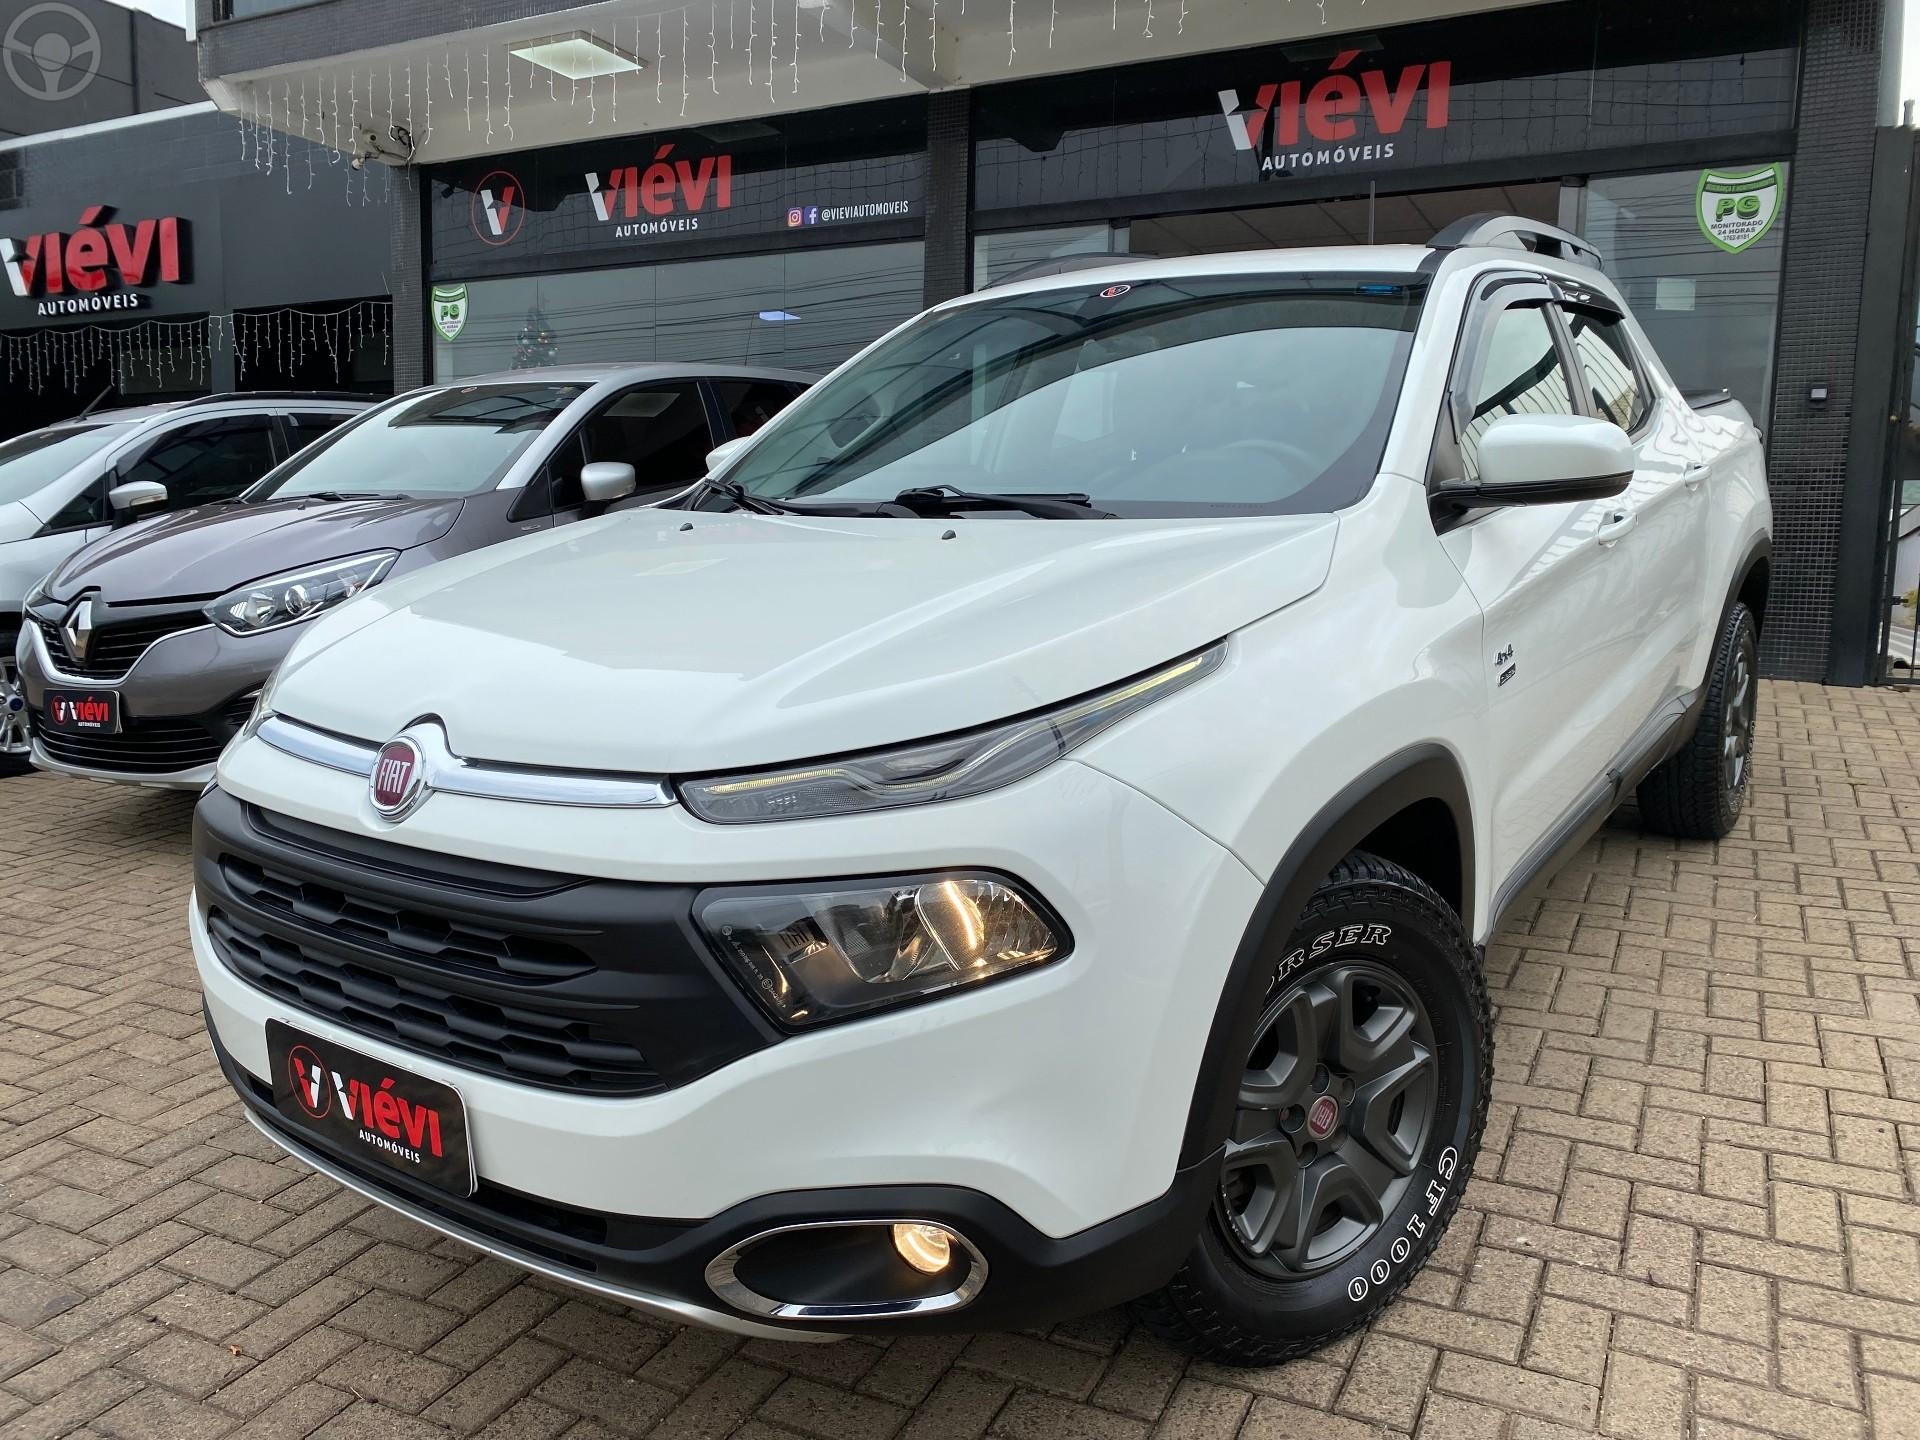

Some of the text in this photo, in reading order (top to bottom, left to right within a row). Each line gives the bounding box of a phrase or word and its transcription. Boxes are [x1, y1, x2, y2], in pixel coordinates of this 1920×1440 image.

[1262, 142, 1395, 171] AUTOMÓVEIS
[821, 201, 909, 221] @VIEVIAUTOMOVEIS
[1716, 195, 1760, 222] PG
[615, 217, 699, 238] AUTOMÓVEIS
[1711, 220, 1763, 229] MONITORADO
[37, 293, 139, 316] AUTOMÓVEIS
[377, 758, 411, 794] FIAT
[1266, 924, 1392, 994] RSER
[1311, 1104, 1333, 1130] FIAT
[359, 1128, 421, 1163] AUTOMÓVEIS
[1347, 1146, 1459, 1302] CF1000
